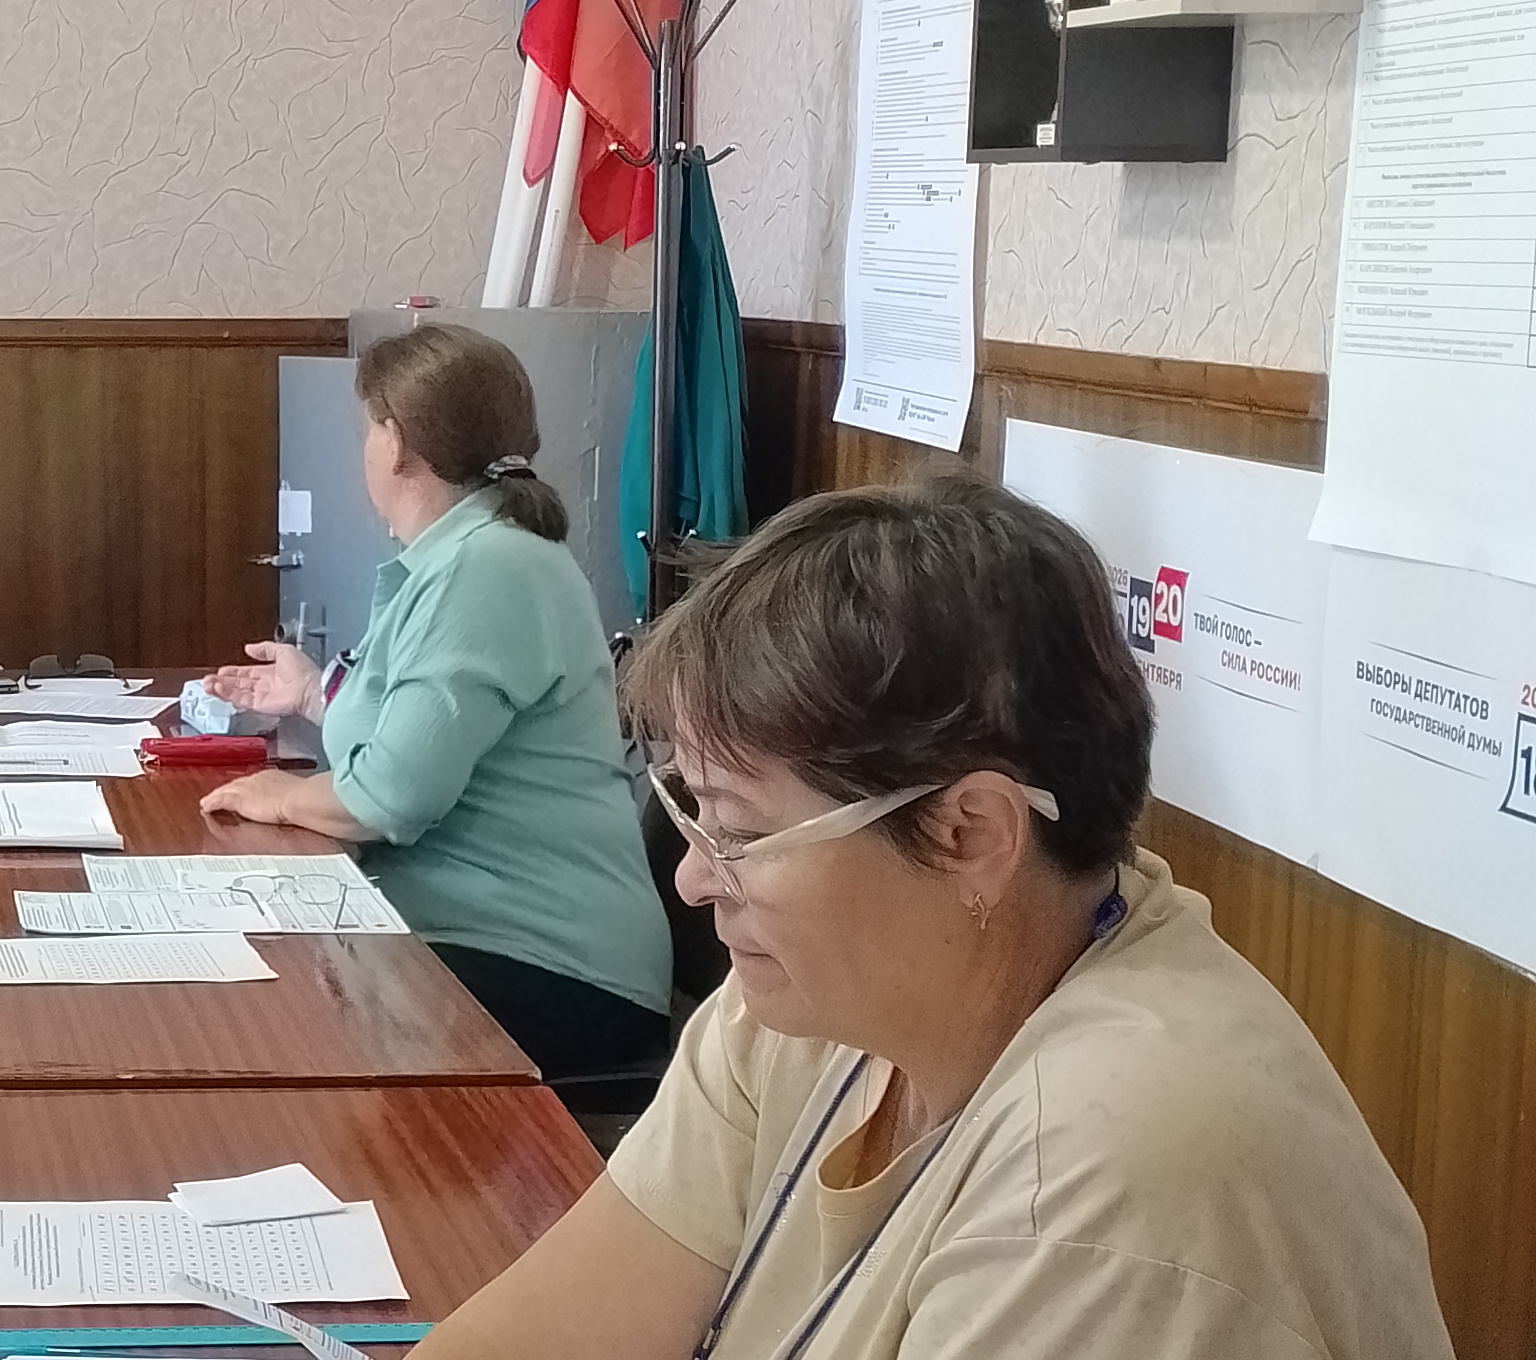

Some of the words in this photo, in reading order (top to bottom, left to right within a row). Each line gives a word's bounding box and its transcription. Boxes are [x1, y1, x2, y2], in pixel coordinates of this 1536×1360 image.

[1130, 594, 1150, 637] 19
[1155, 580, 1182, 626] 20
[1194, 612, 1218, 637] ТВОЙ
[1220, 620, 1252, 648] ГОЛОС
[1221, 649, 1247, 675] СИЛА
[1250, 659, 1301, 691] РОССИИ!
[1356, 660, 1412, 695] ВЫБОРЫ
[1414, 678, 1490, 721] ДЕПУТАТОВ
[1370, 698, 1465, 745] ГОСУДАРСТВЕННОЙ
[1466, 732, 1502, 757] ДУМЫ
